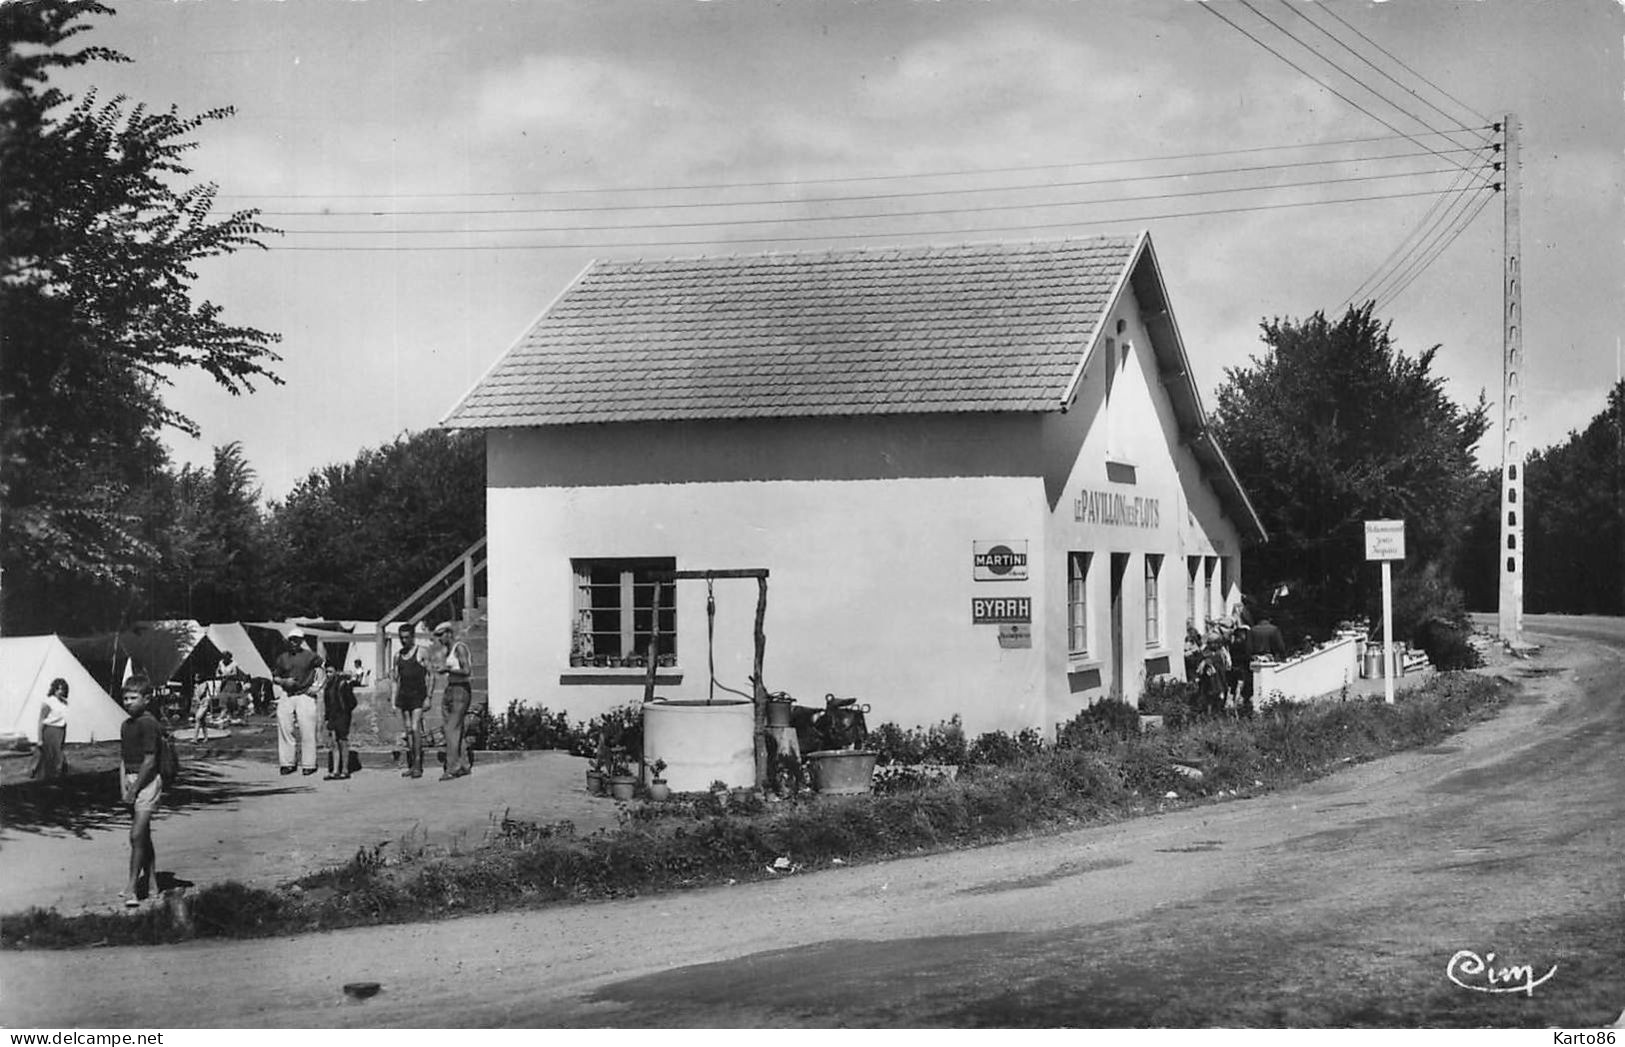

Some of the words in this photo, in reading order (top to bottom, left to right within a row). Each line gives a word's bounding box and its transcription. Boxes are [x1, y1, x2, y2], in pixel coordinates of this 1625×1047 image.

[1082, 490, 1126, 526] PAVILLON
[1134, 497, 1159, 528] FLOTS
[976, 555, 1026, 566] MARTINI
[975, 600, 1029, 617] BYRRH
